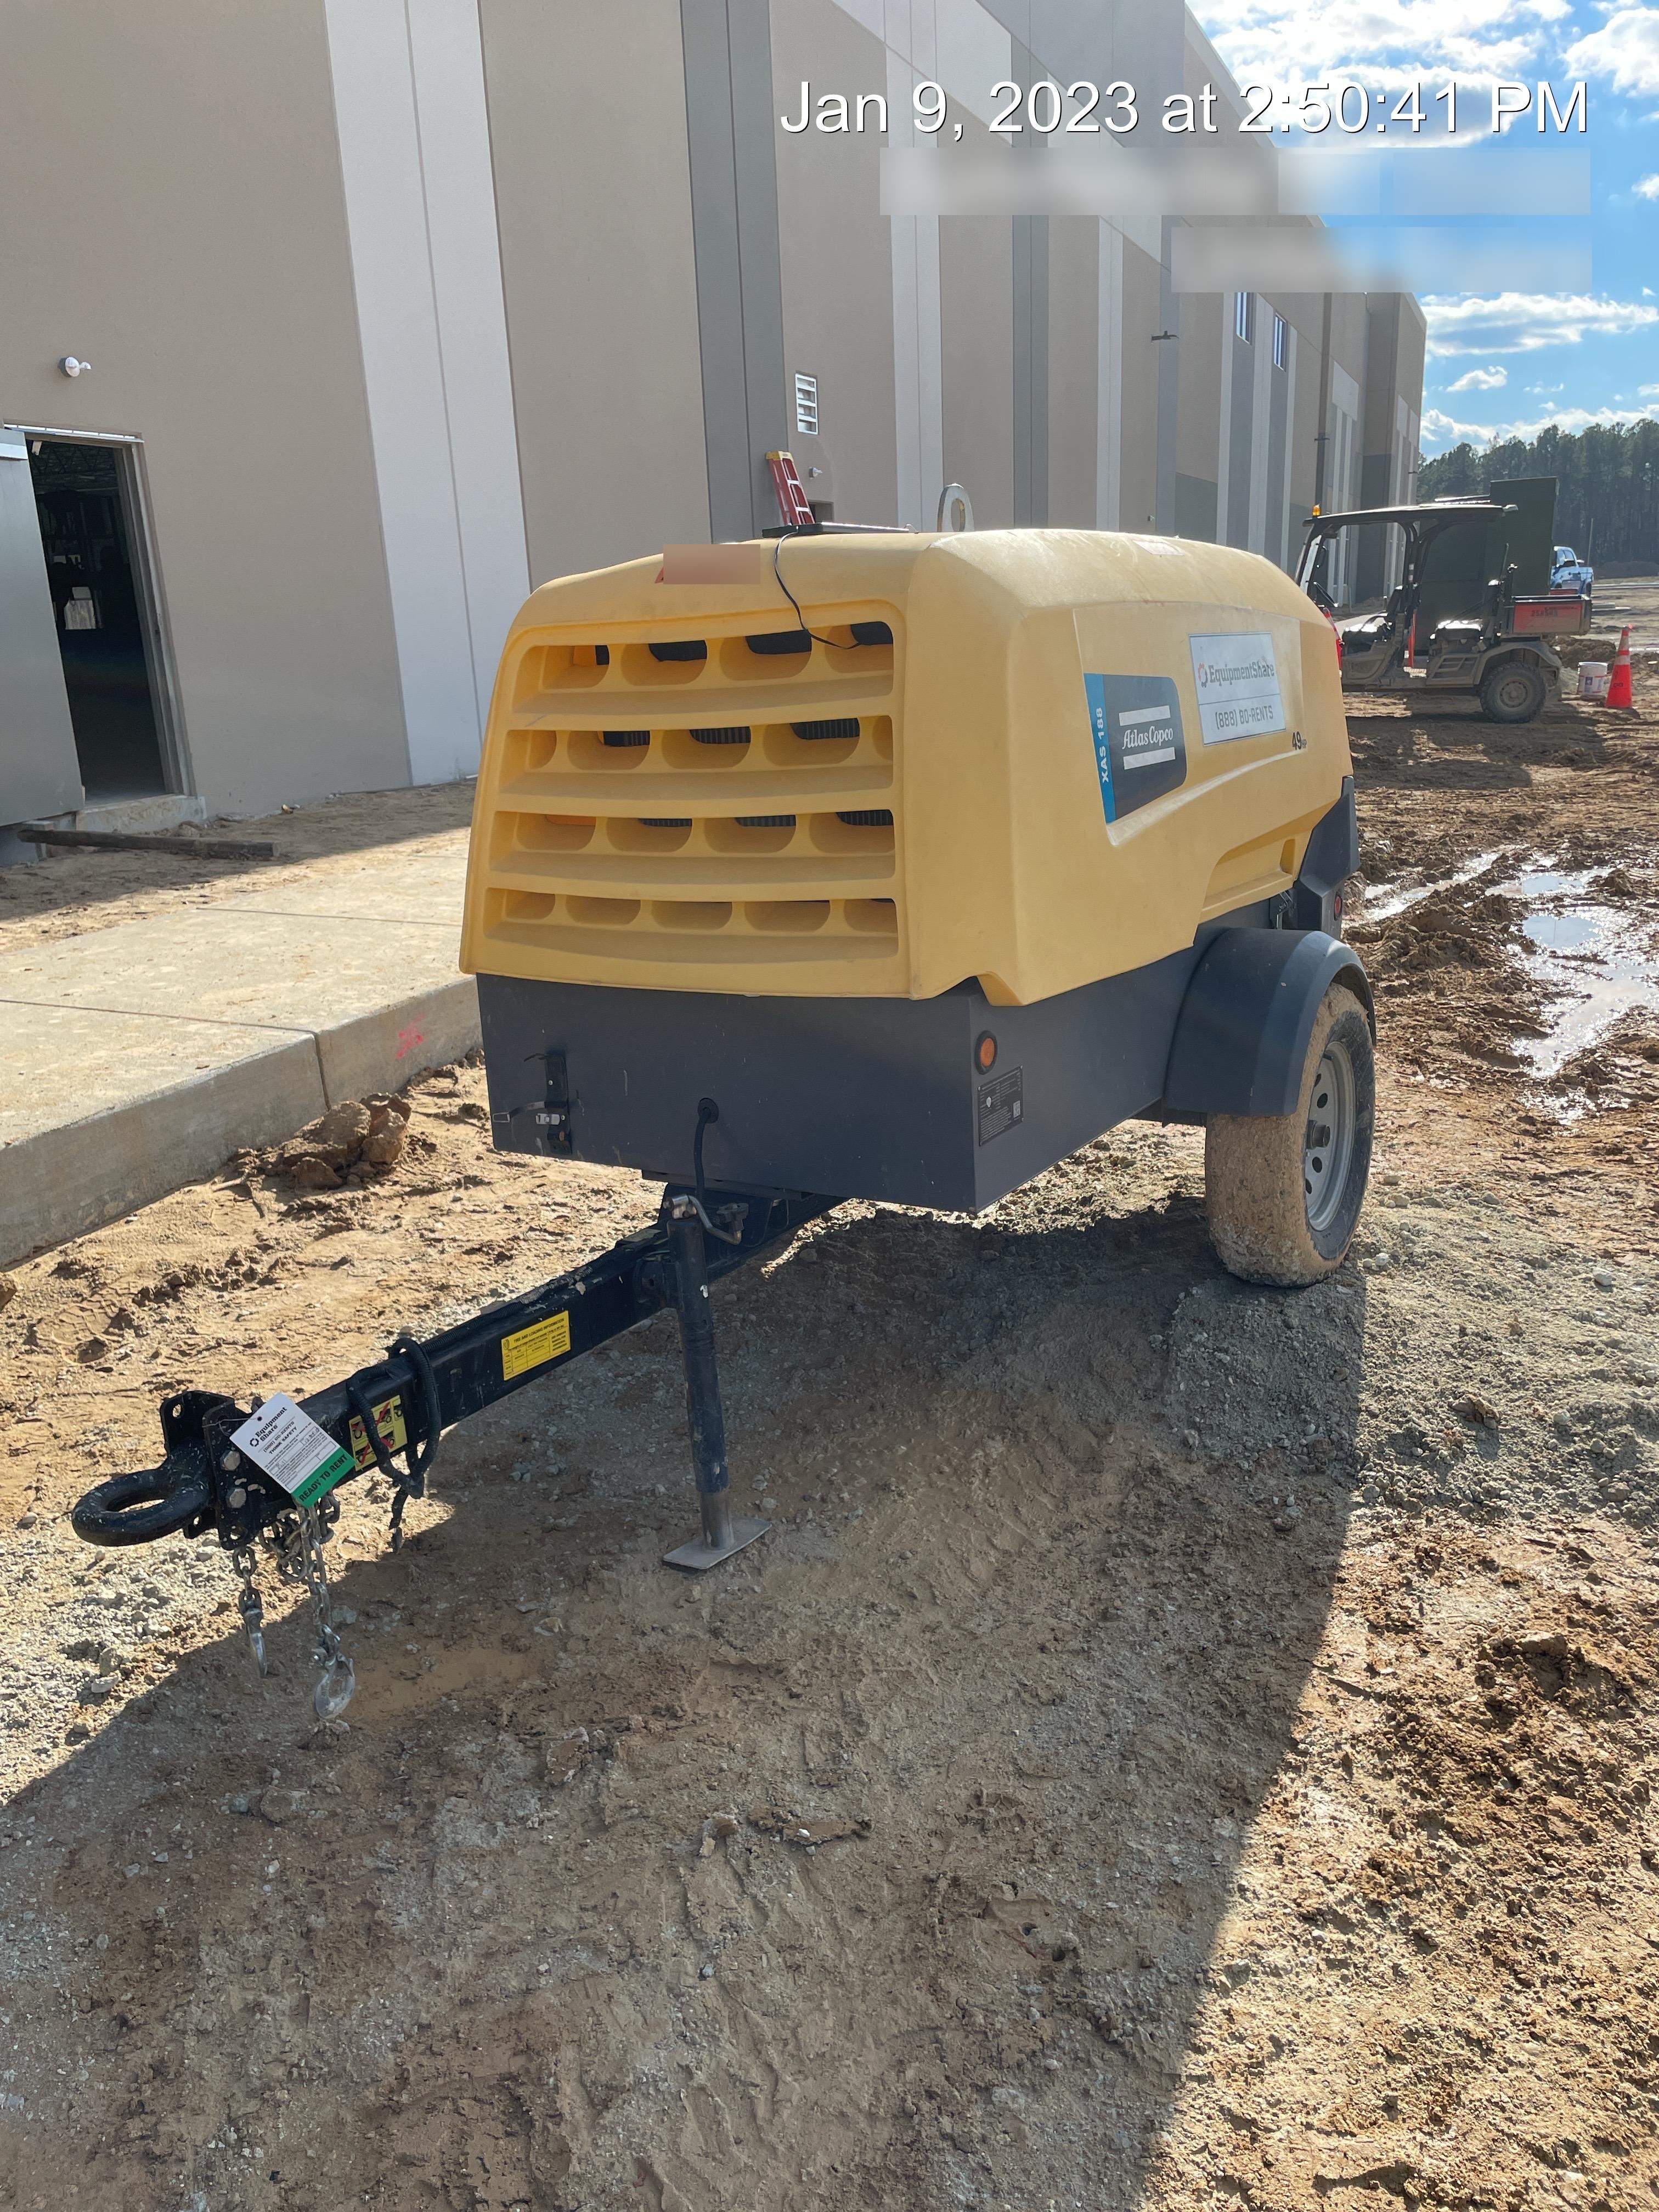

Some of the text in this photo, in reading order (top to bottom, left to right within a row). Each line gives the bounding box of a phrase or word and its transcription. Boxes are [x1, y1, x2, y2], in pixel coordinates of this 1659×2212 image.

[1208, 660, 1275, 687] EquipmentShare
[1215, 709, 1238, 730] (888)
[1096, 707, 1109, 783] XAS 188
[1292, 731, 1302, 751] 49
[255, 1406, 287, 1437] Equipment
[259, 1425, 278, 1442] Share
[298, 1453, 348, 1502] READY TO RENT
